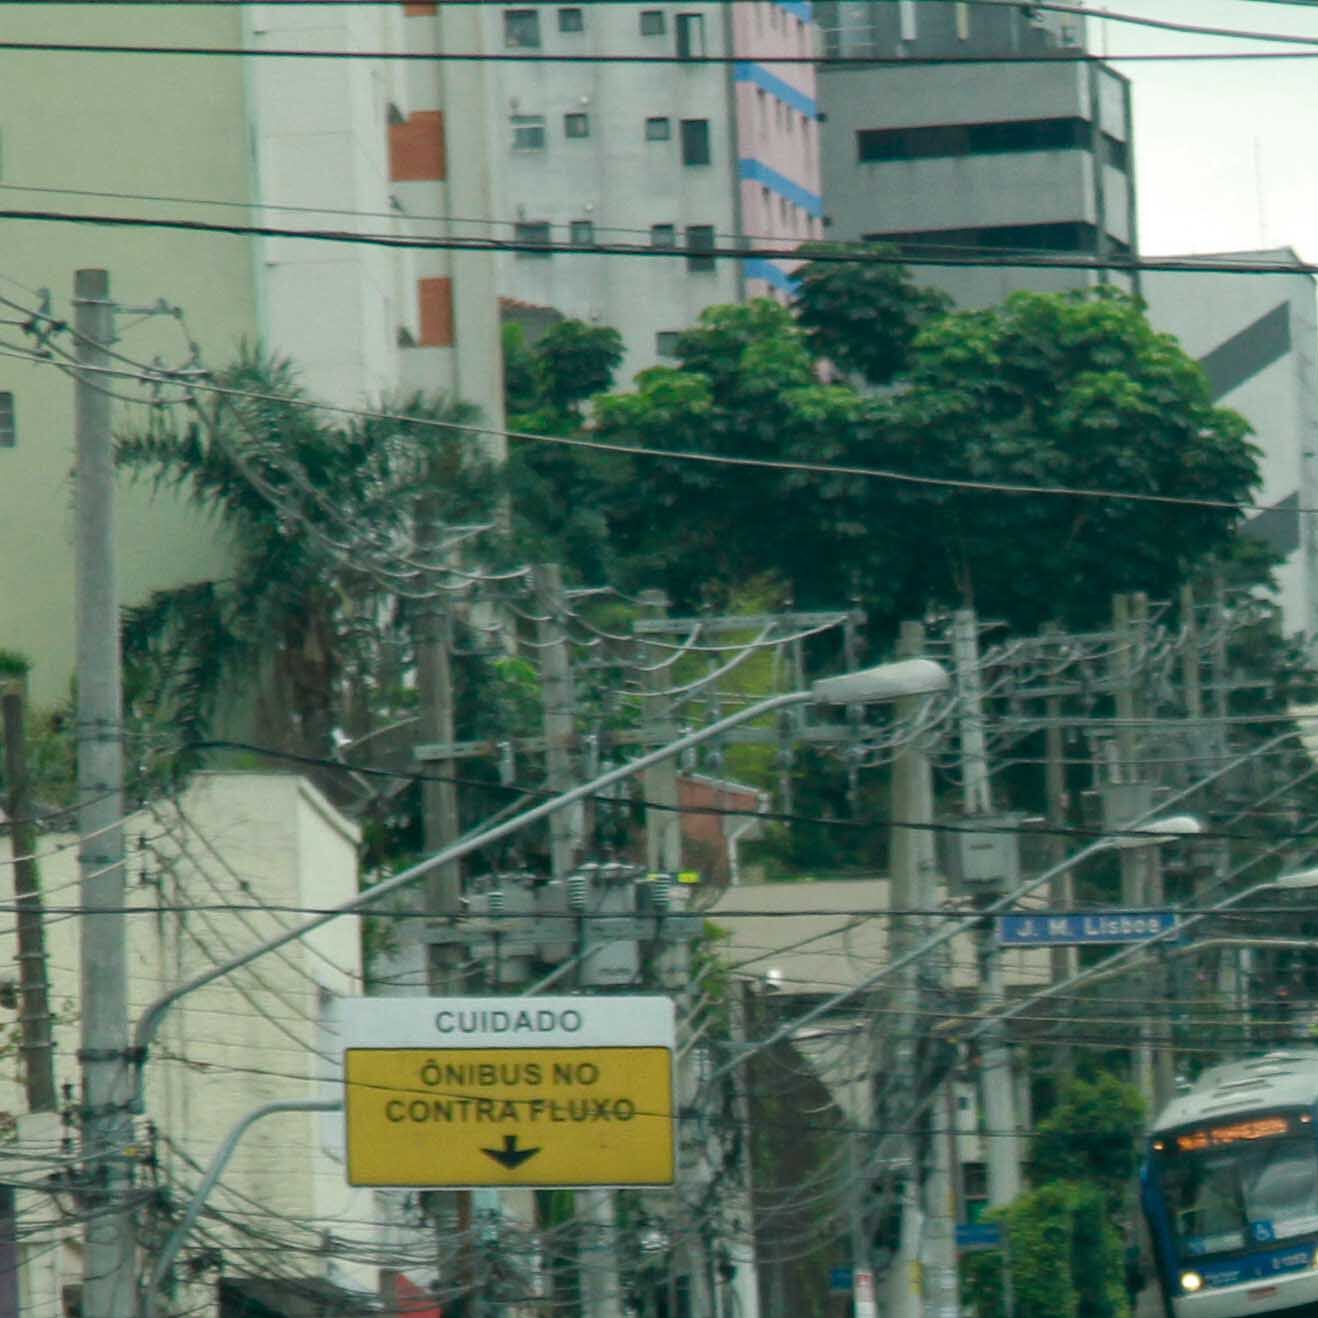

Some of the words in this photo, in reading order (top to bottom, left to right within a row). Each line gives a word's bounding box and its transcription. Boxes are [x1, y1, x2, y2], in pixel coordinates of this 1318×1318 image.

[435, 1009, 582, 1034] CUIDADO
[420, 1058, 543, 1087] ÔNIBUS
[553, 1062, 600, 1086] NO
[385, 1099, 519, 1123] CONTRA
[530, 1098, 637, 1122] FLUXO
